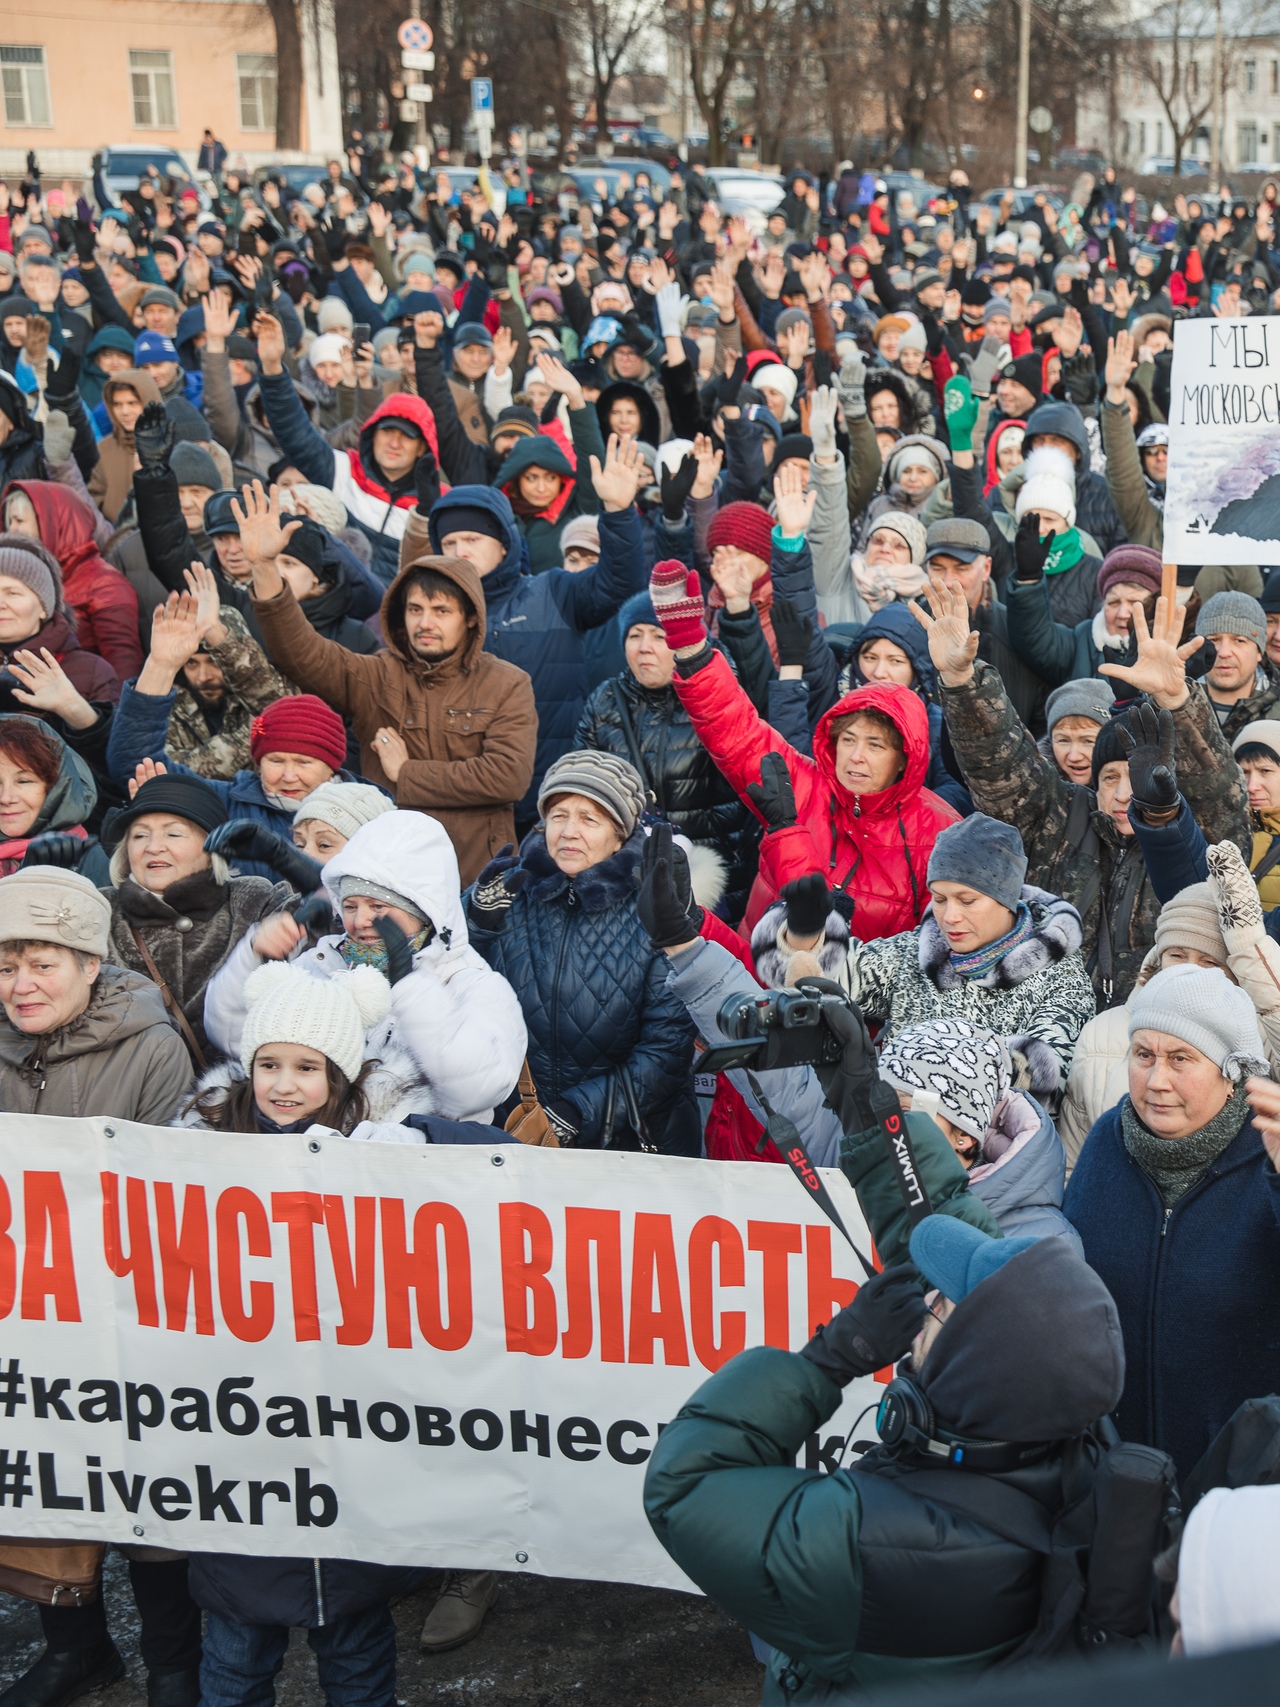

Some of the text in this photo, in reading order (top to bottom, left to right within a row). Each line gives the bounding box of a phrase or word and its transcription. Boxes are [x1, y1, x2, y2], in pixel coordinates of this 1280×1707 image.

[1208, 323, 1270, 368] МЫ
[787, 1147, 820, 1191] GH5
[885, 1114, 924, 1207] LUMIX G
[99, 1170, 474, 1352] ЧИСТУЮ
[0, 1449, 339, 1528] #Livekrb
